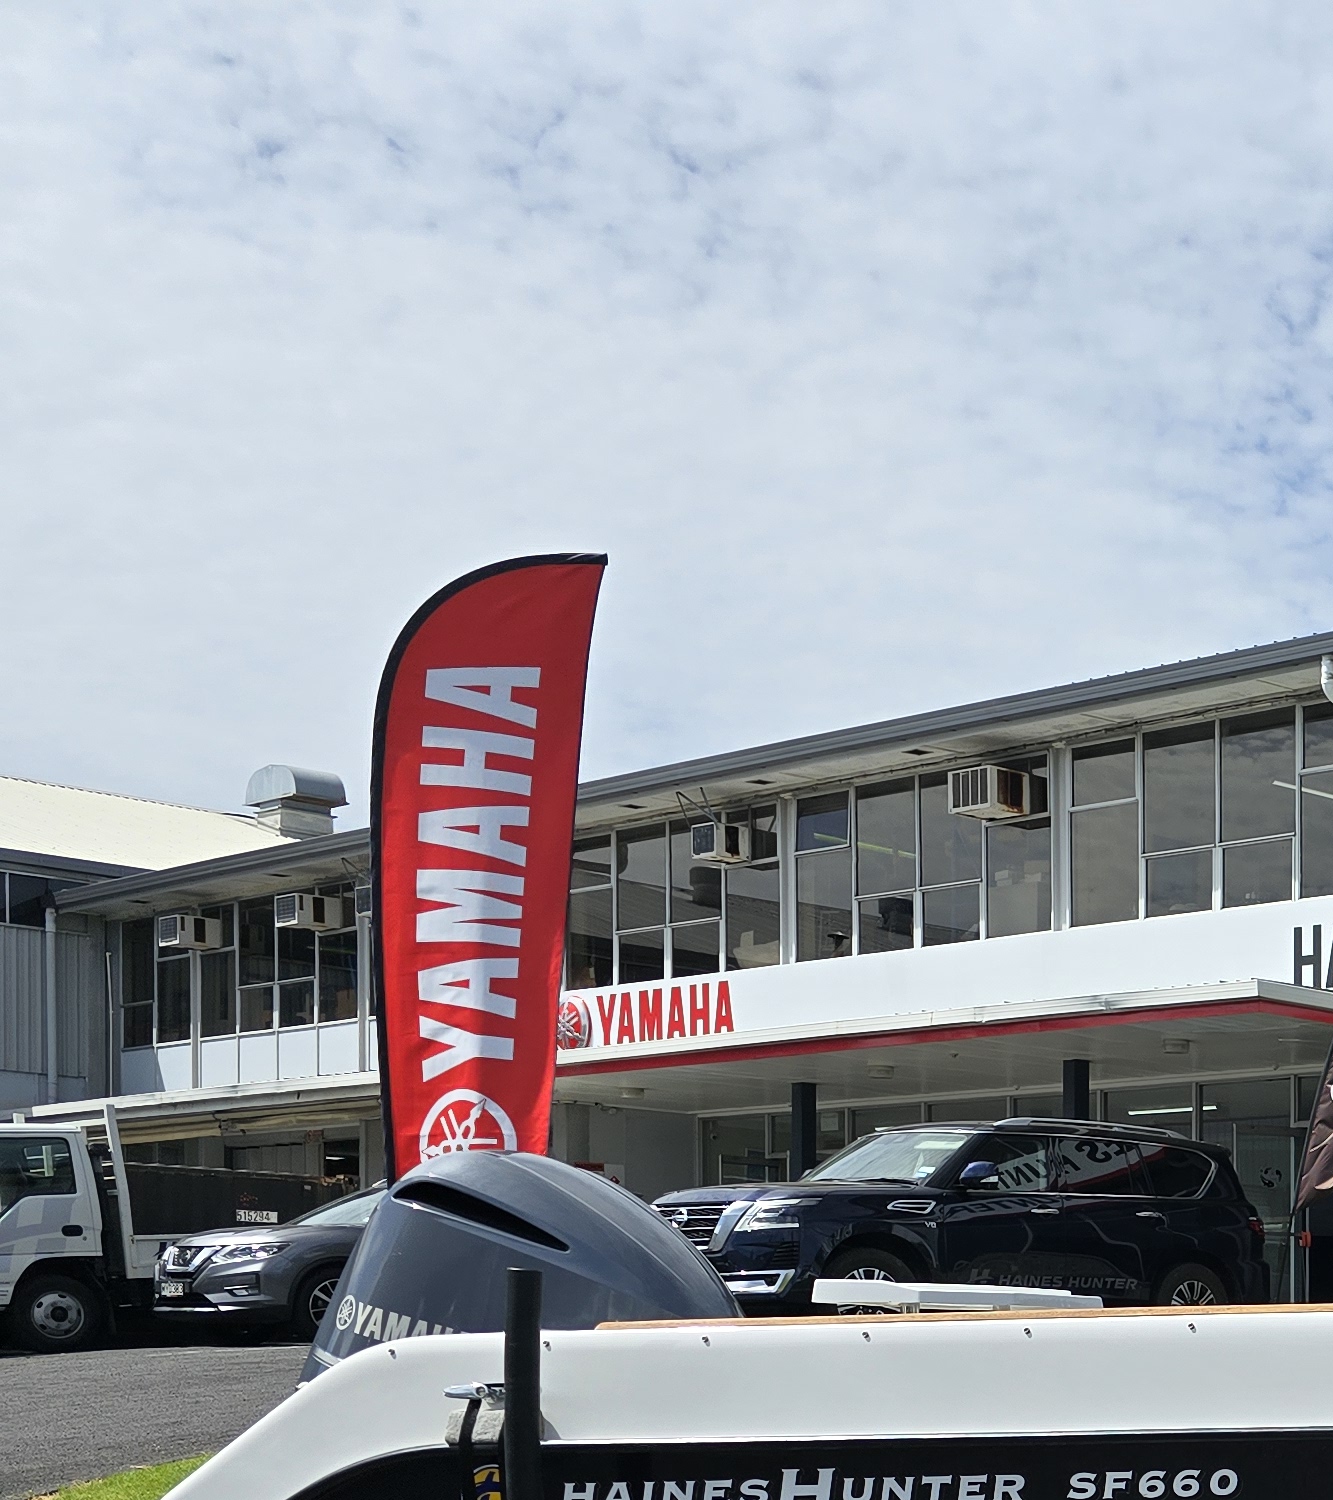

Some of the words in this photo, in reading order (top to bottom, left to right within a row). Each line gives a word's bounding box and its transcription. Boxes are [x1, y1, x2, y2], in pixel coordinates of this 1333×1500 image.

[416, 666, 541, 1083] YAMAHA
[596, 980, 735, 1047] YAMAHA
[1000, 1273, 1063, 1288] HAINES
[1067, 1275, 1138, 1291] HUNTER
[353, 1301, 468, 1342] YAMA
